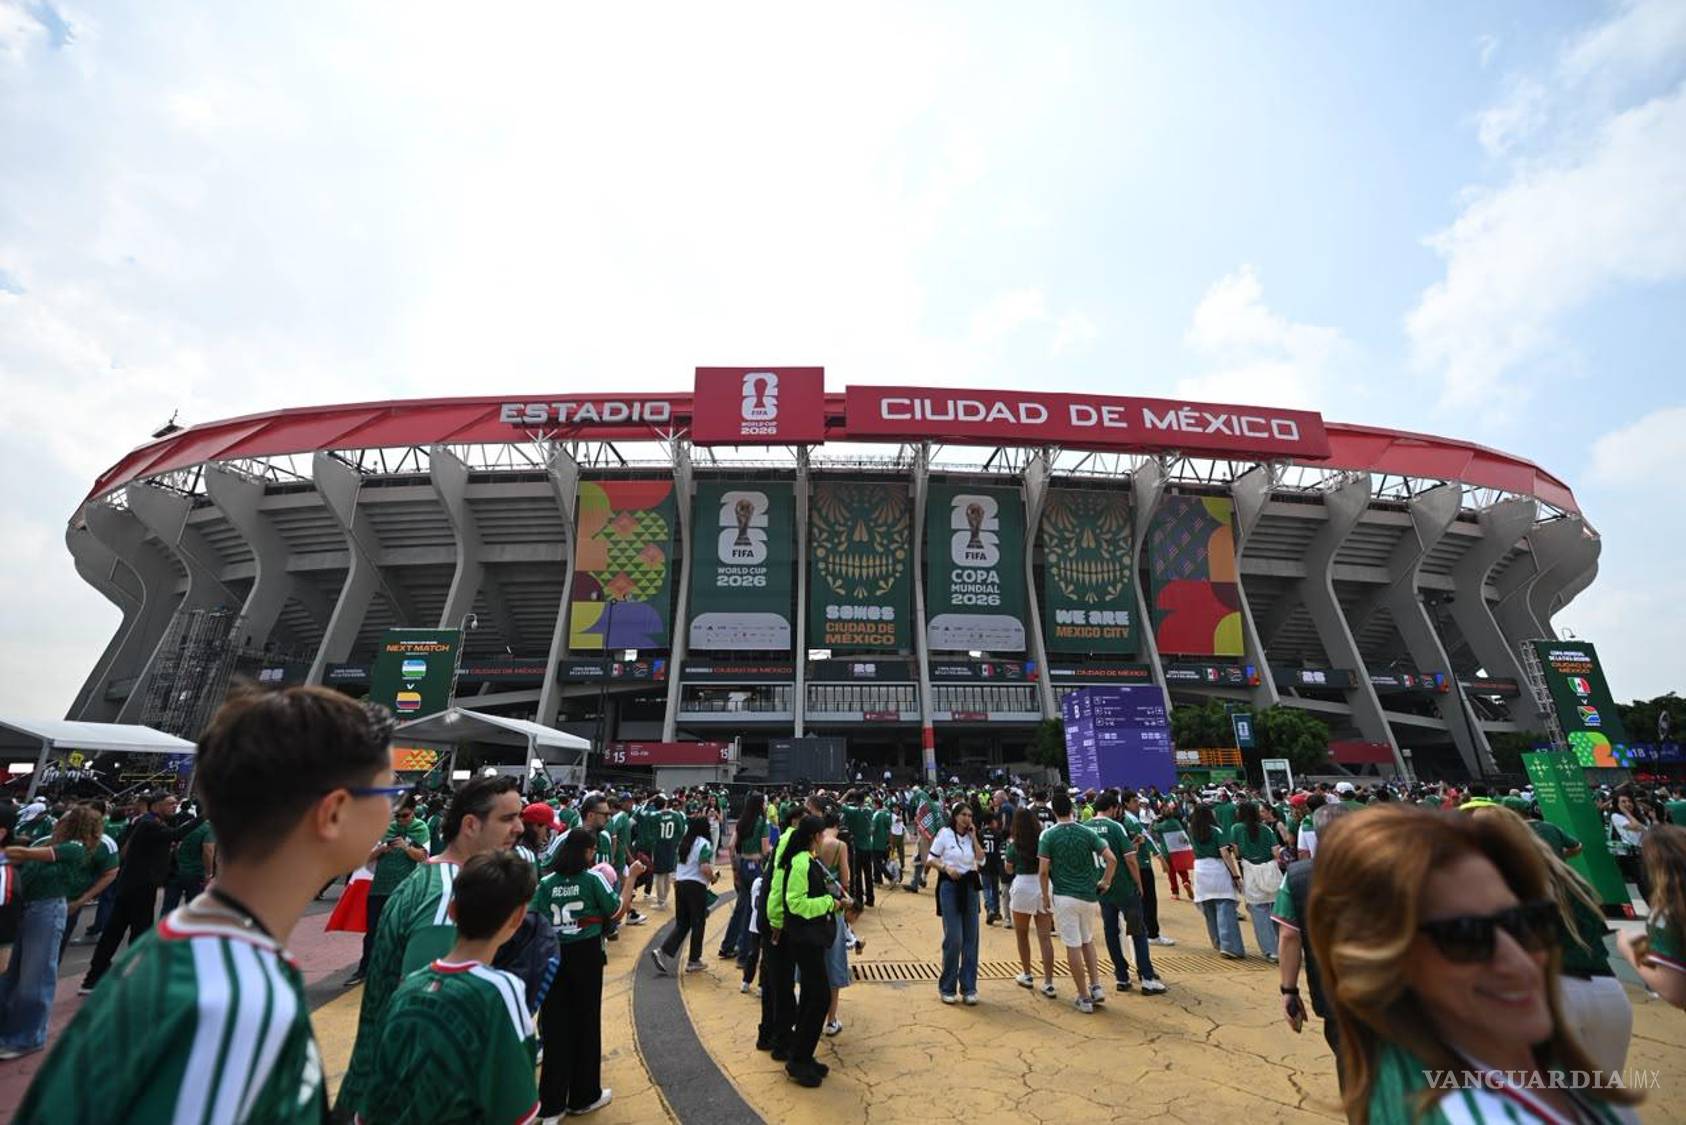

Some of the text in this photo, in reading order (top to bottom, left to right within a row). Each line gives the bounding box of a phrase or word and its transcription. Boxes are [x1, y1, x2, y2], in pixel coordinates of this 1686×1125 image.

[500, 401, 671, 423] ESTADIO
[881, 398, 1299, 441] CIUDAD DE MÉXICO
[741, 427, 778, 435] 2026
[731, 549, 755, 558] FIFA
[965, 551, 988, 561] FIFA
[717, 567, 767, 575] WORLD CUP
[951, 569, 1000, 583] COPA
[716, 575, 767, 587] 2026
[951, 584, 1000, 593] MUNDIAL
[951, 594, 1000, 606] 2026
[825, 605, 895, 620] SOMOS
[1055, 609, 1130, 625] WE ARE
[825, 622, 895, 633] CIUDAD DE
[1056, 626, 1130, 638] MEXICO CITY
[825, 633, 896, 645] MÉXICO
[386, 644, 450, 652] NEXT MATCH
[613, 751, 626, 764] 15
[660, 821, 675, 839] 10
[551, 884, 580, 898] REGINA
